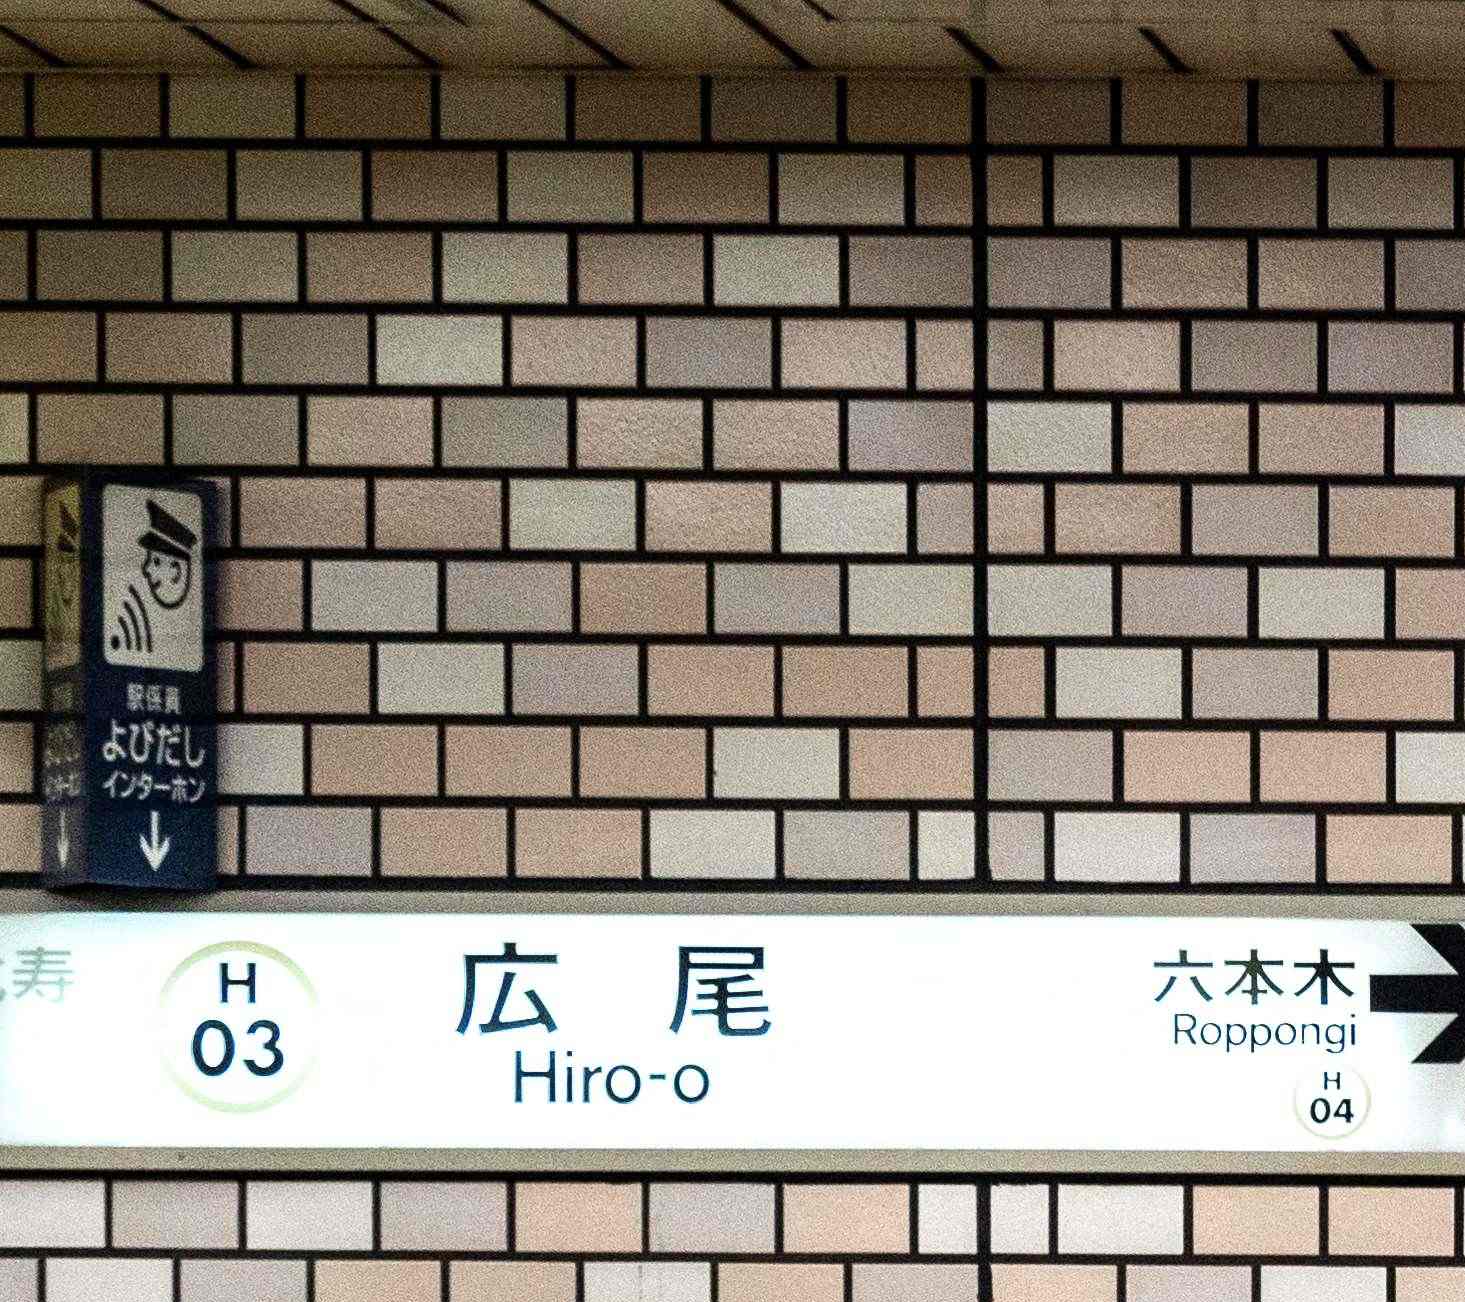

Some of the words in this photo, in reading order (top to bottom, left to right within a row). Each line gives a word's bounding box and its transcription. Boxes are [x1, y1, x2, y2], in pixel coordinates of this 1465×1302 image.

[102, 719, 205, 768] よびだし
[103, 771, 205, 803] インターホン
[220, 962, 256, 1004] H
[1153, 948, 1356, 1006] 六本木
[191, 1019, 284, 1077] 03
[1174, 1013, 1356, 1054] Roppongi
[515, 1050, 710, 1104] Hiro-o
[1323, 1071, 1341, 1090] H
[1309, 1097, 1354, 1124] 04
